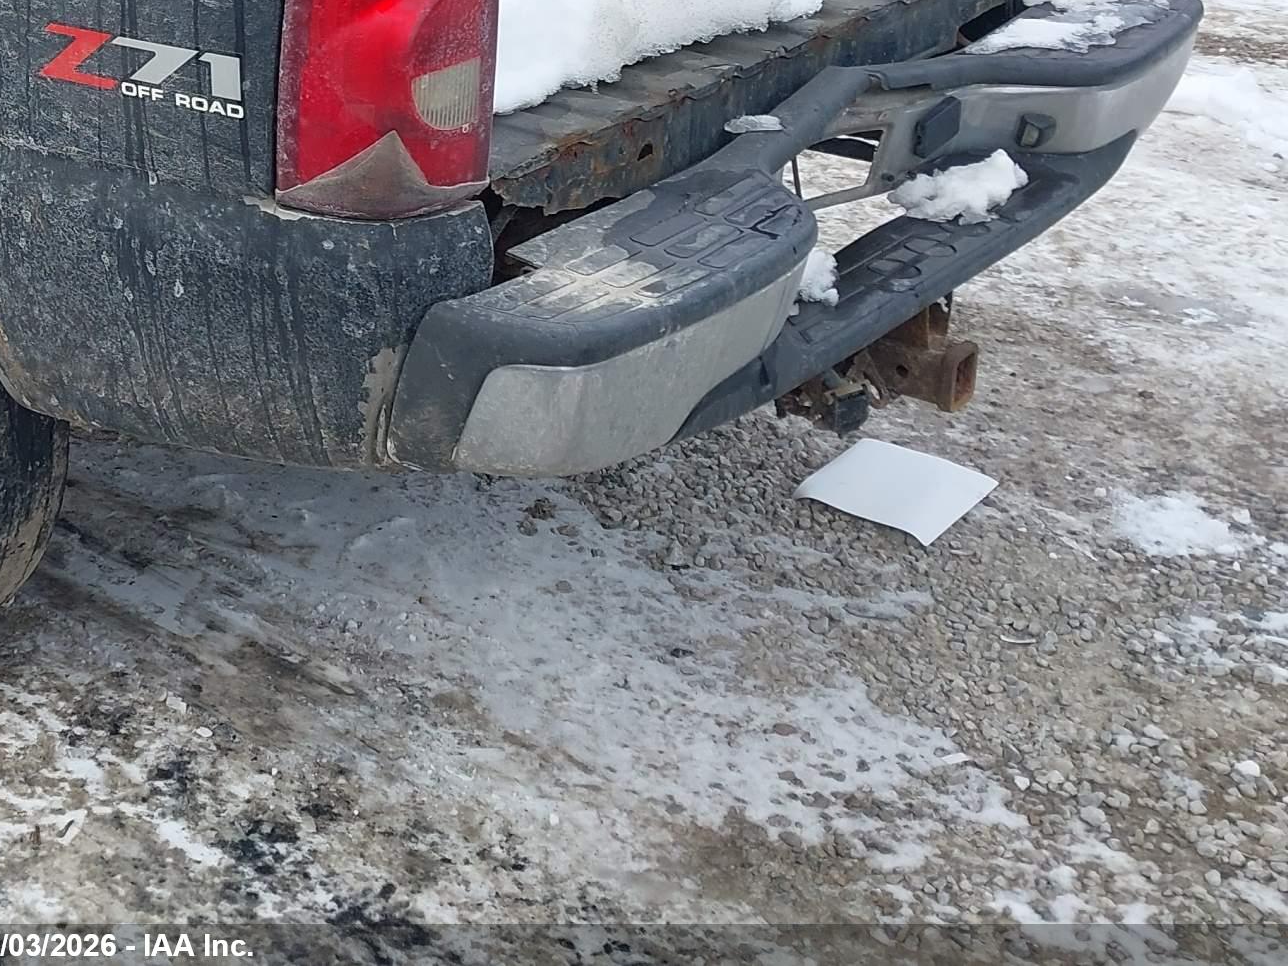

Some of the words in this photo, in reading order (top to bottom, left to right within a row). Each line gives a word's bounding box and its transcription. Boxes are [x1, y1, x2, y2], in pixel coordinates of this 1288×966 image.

[41, 22, 242, 102] Z71
[121, 81, 164, 102] OFF
[174, 92, 245, 120] ROAD
